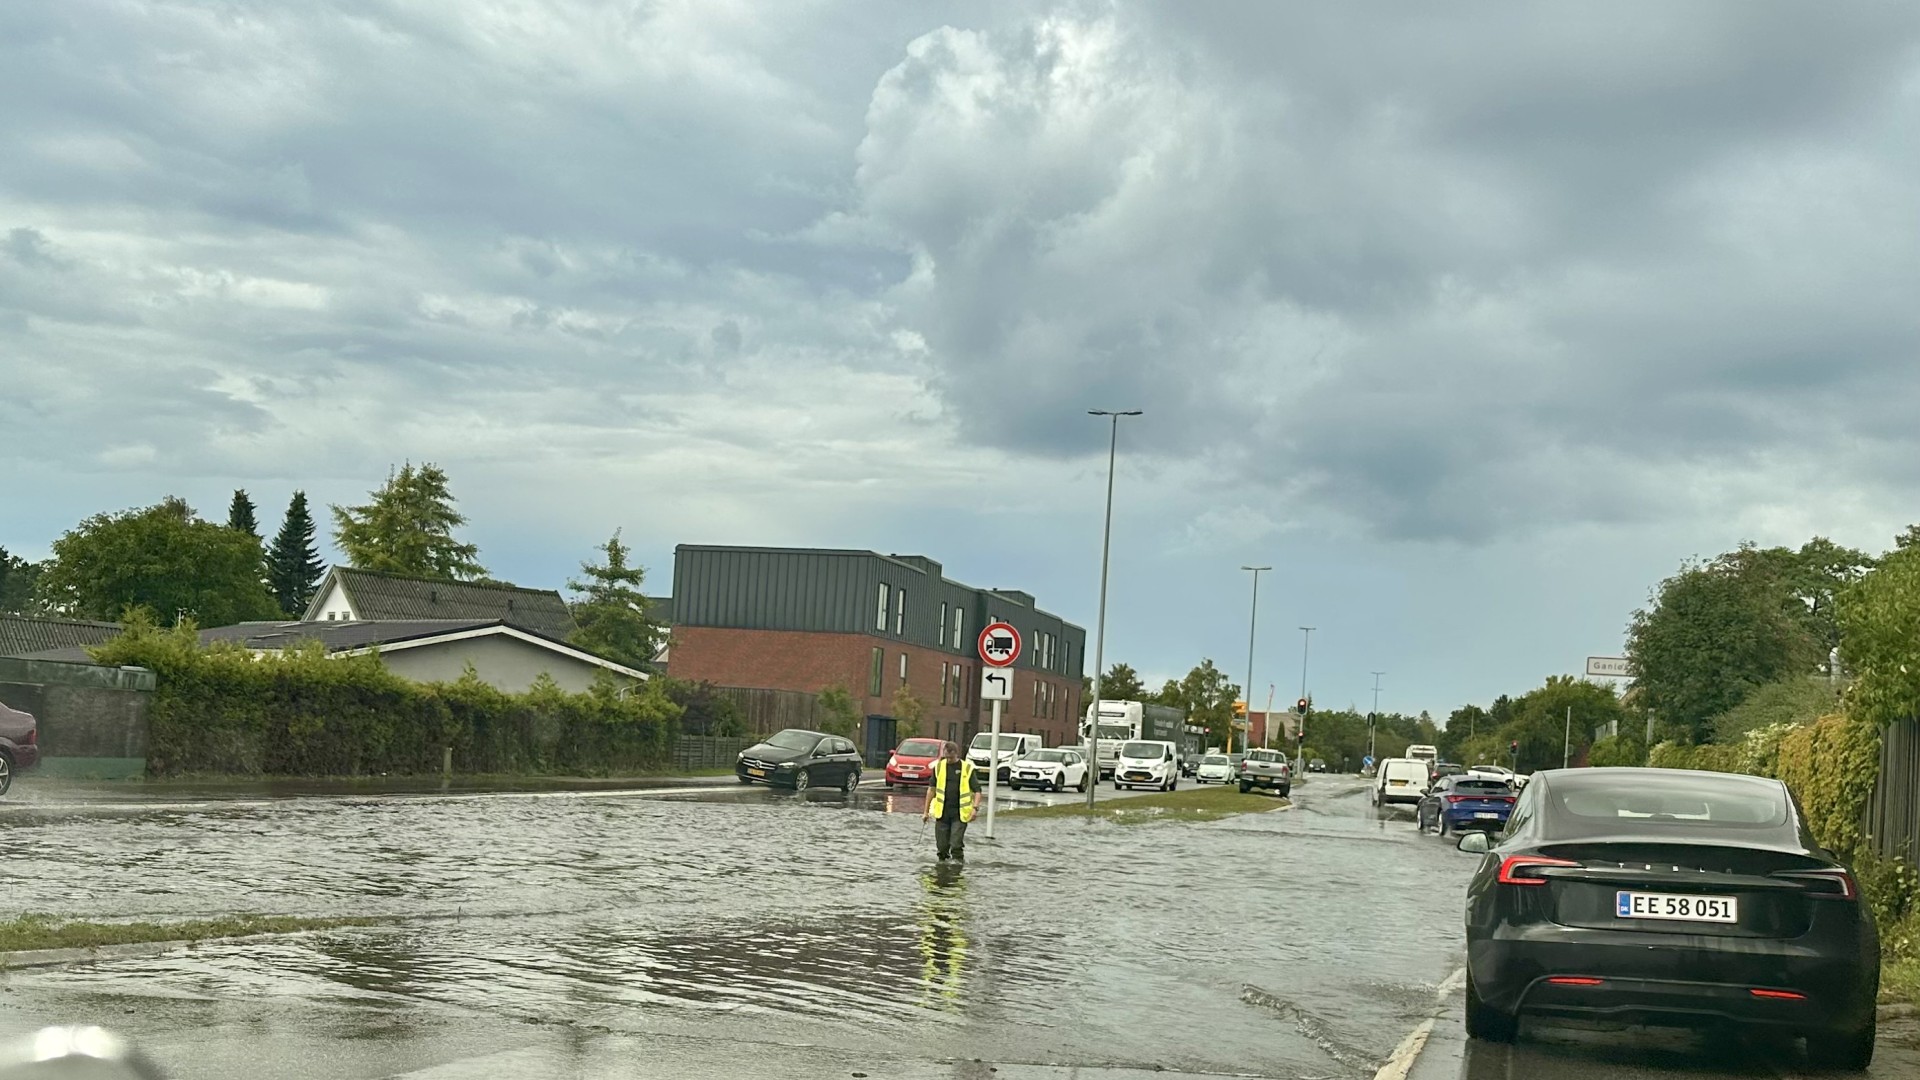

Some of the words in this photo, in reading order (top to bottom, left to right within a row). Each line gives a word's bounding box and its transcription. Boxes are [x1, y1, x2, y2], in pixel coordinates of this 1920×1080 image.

[1634, 897, 1659, 914] EE
[1666, 898, 1690, 916] 58
[1696, 900, 1731, 918] 051
